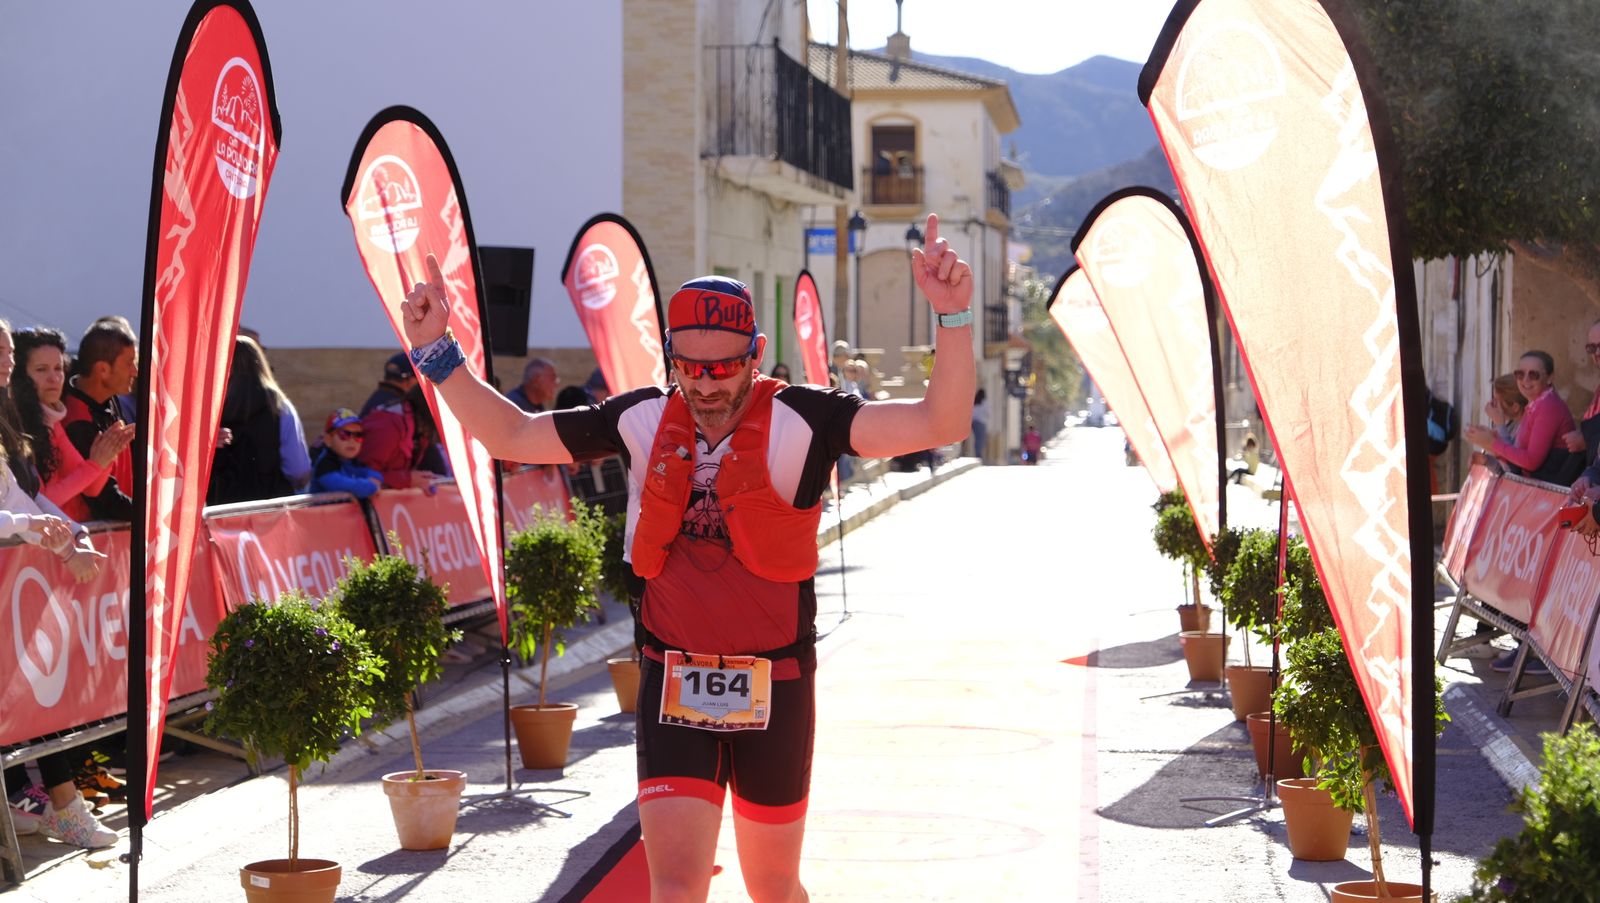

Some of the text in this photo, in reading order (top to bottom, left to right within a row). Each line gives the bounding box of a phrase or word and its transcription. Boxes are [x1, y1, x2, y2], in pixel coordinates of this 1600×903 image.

[216, 139, 226, 157] LA
[686, 659, 714, 668] OLVORA
[684, 671, 750, 698] 164
